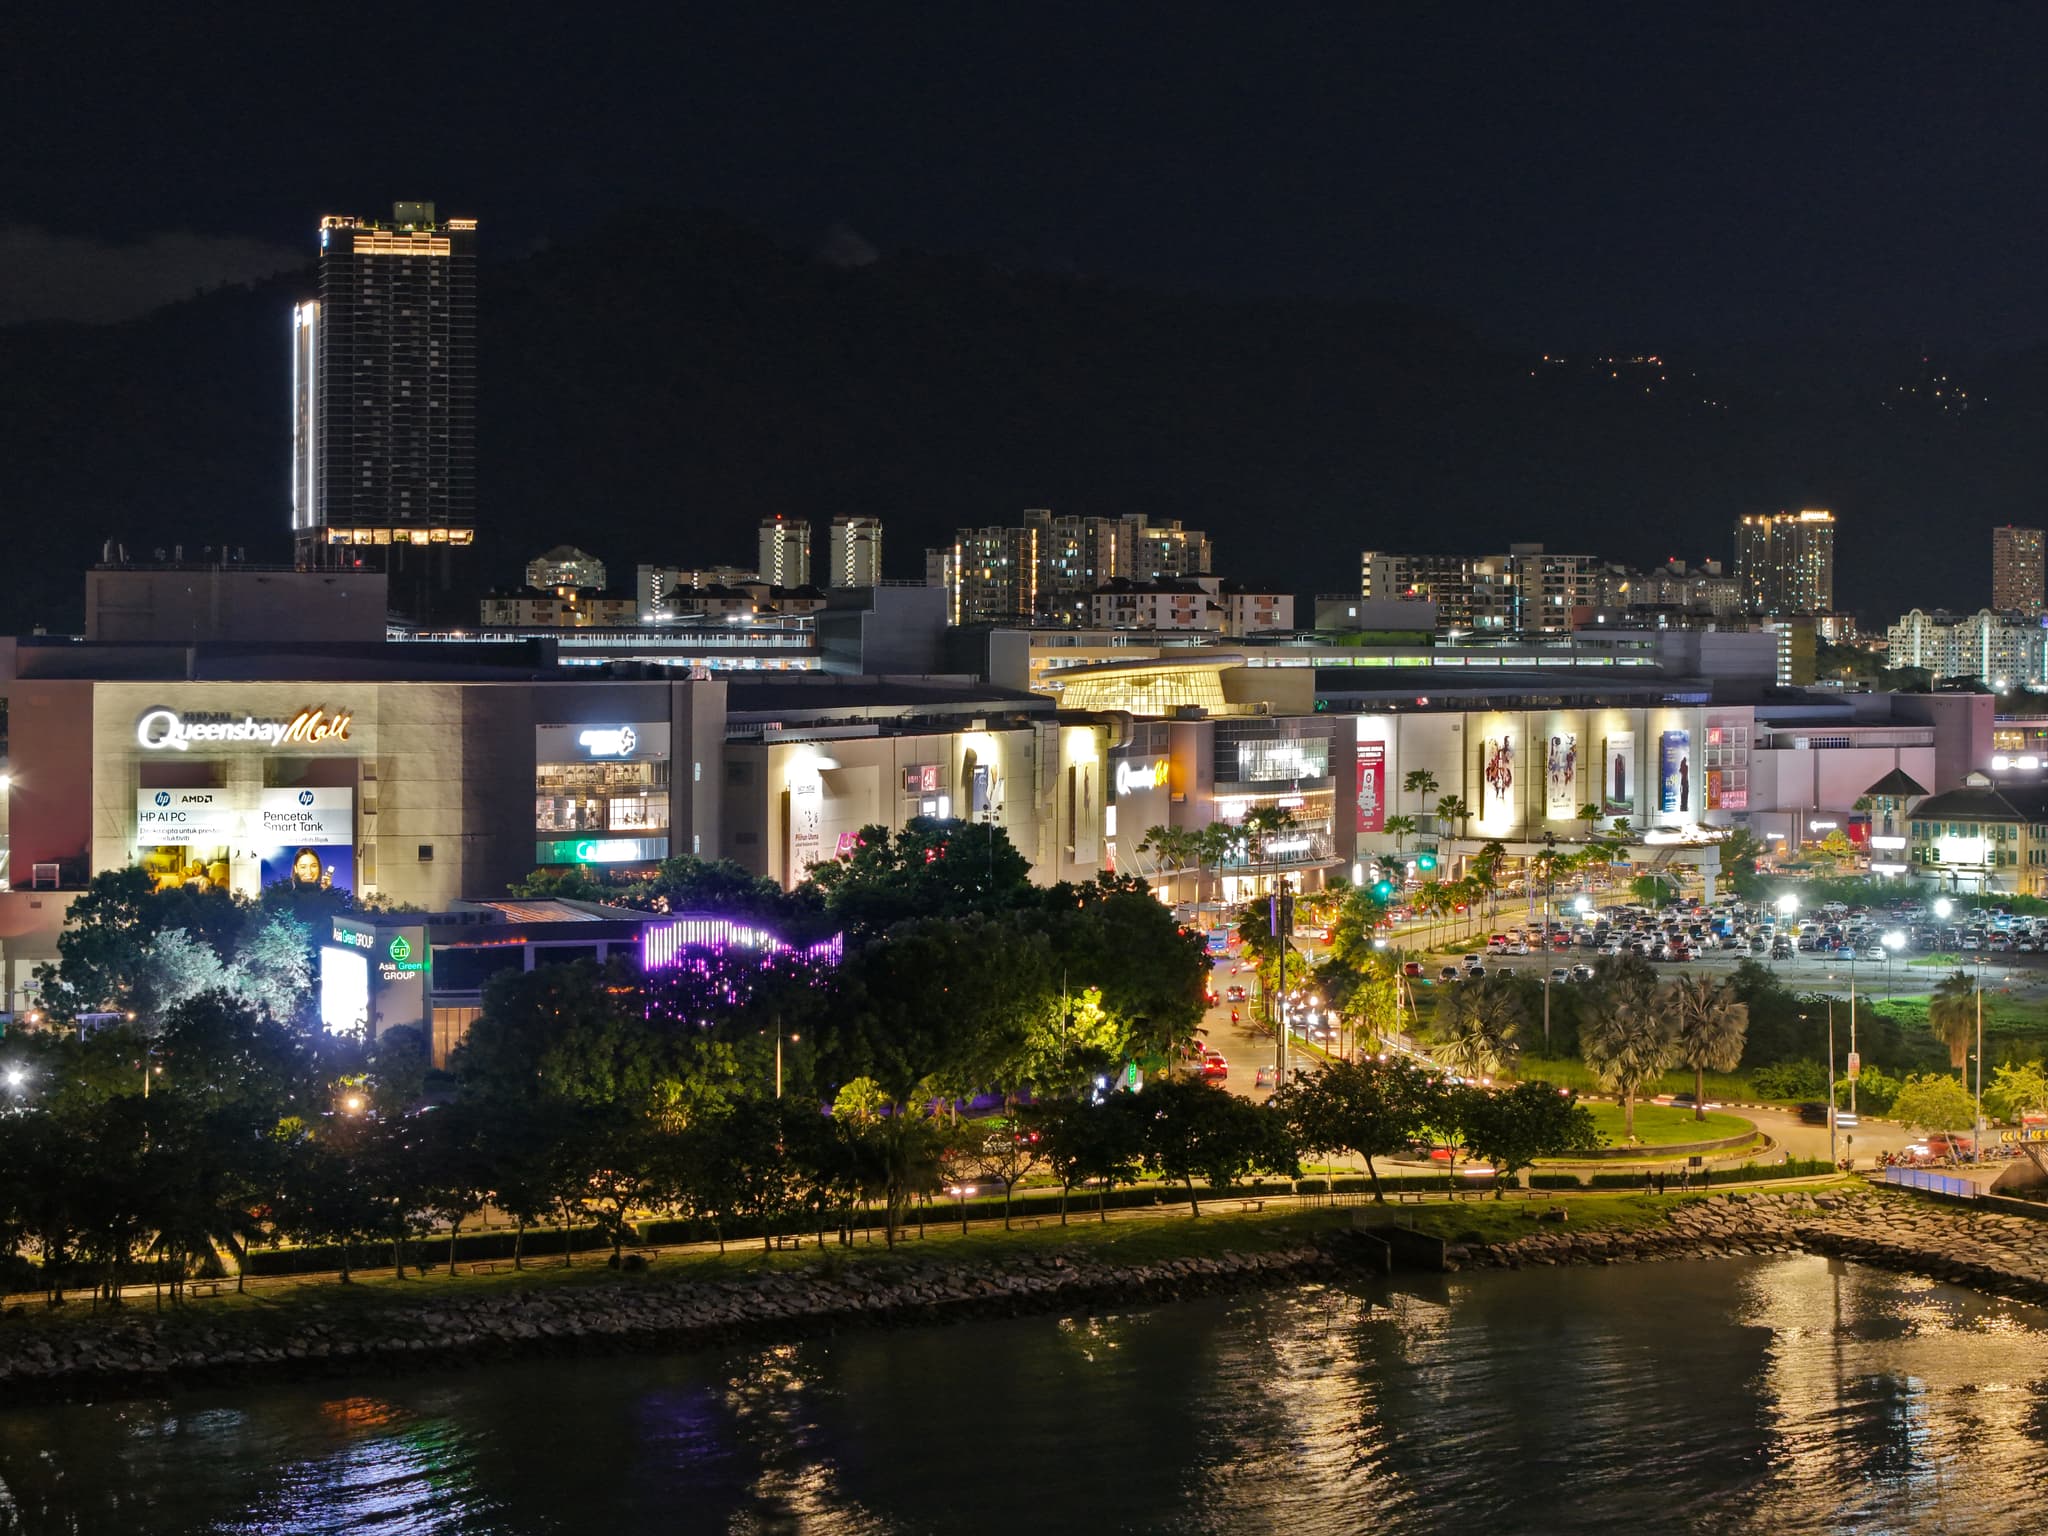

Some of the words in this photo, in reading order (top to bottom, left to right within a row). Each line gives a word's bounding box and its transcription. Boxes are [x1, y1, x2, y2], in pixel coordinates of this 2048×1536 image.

[138, 711, 288, 751] Queensbay
[284, 711, 350, 743] Mall
[155, 791, 171, 807] hp
[181, 795, 205, 803] AMD
[299, 790, 314, 806] hp
[140, 812, 156, 822] HP
[158, 812, 169, 822] AI
[171, 811, 187, 822] PC
[263, 811, 314, 822] Pencetak
[263, 822, 297, 832] Smart
[299, 821, 324, 832] Tank
[333, 928, 342, 942] Asia
[343, 930, 355, 944] Green
[356, 933, 373, 948] GROUP
[398, 961, 422, 970] Green
[384, 972, 415, 980] GROUP
